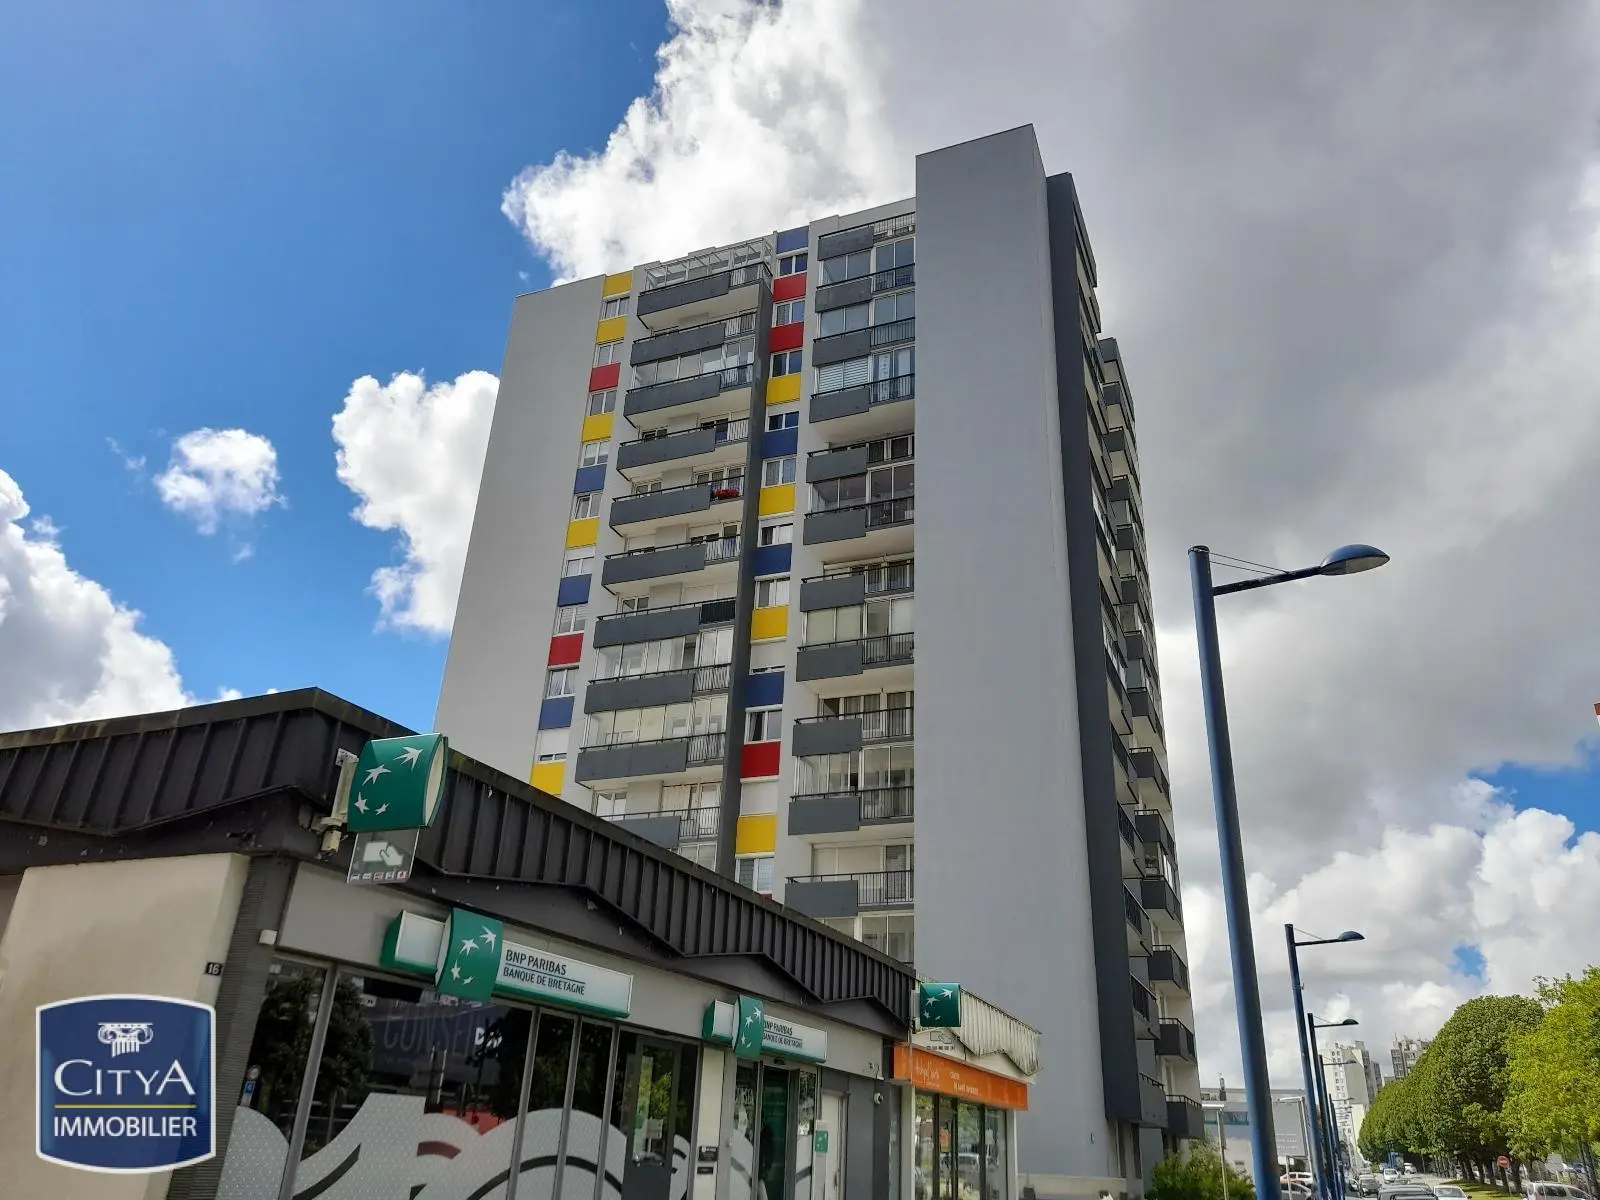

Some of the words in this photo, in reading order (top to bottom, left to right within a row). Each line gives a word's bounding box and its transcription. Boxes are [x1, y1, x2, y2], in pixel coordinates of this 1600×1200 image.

[207, 963, 220, 975] 16
[505, 949, 526, 964] BNP
[527, 955, 567, 976] PARIBAS
[503, 966, 535, 984] BANQUE
[536, 974, 547, 986] DE
[547, 976, 585, 996] BRETAGNE
